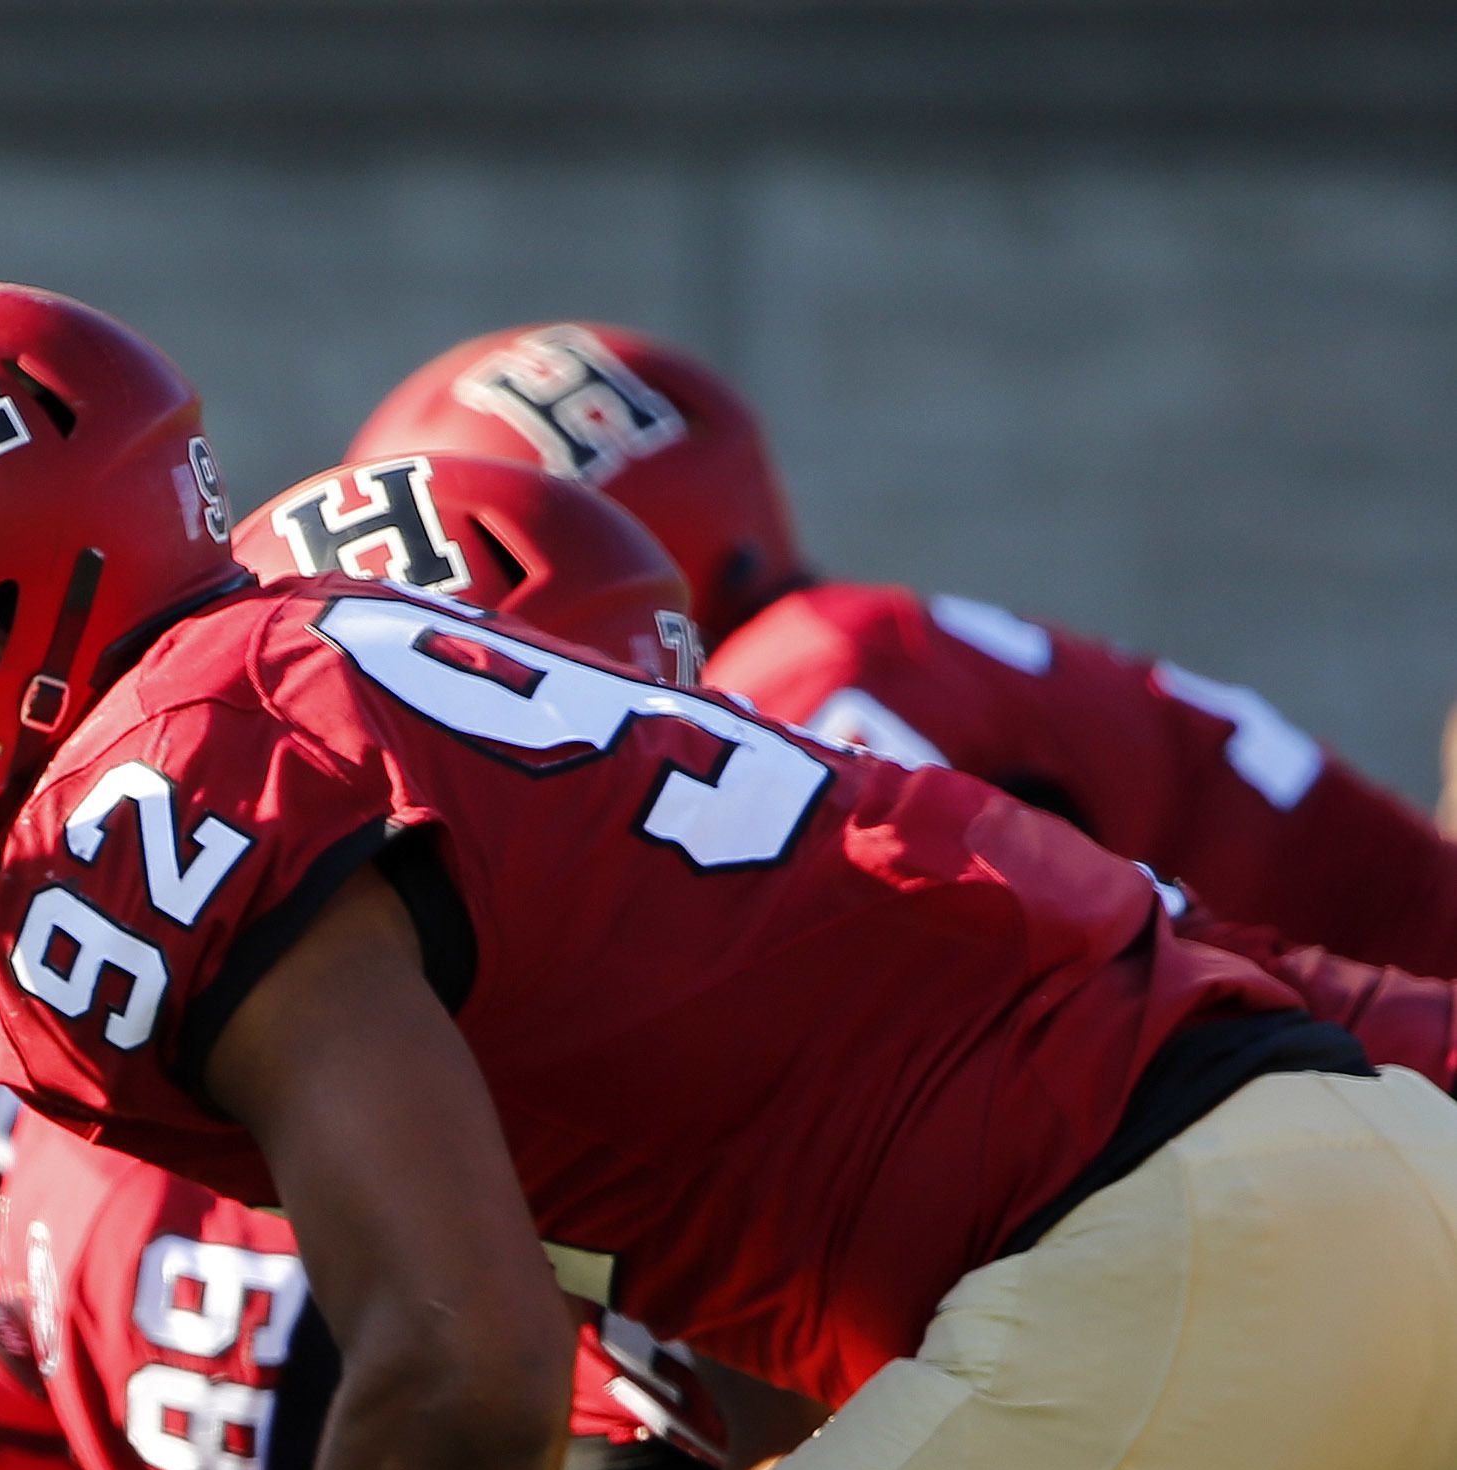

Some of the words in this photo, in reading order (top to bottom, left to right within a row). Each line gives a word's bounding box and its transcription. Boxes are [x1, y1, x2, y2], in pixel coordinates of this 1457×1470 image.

[452, 323, 686, 483] H
[271, 455, 472, 595] H
[653, 608, 705, 687] 7
[314, 590, 832, 868] 9
[10, 758, 255, 1052] 92
